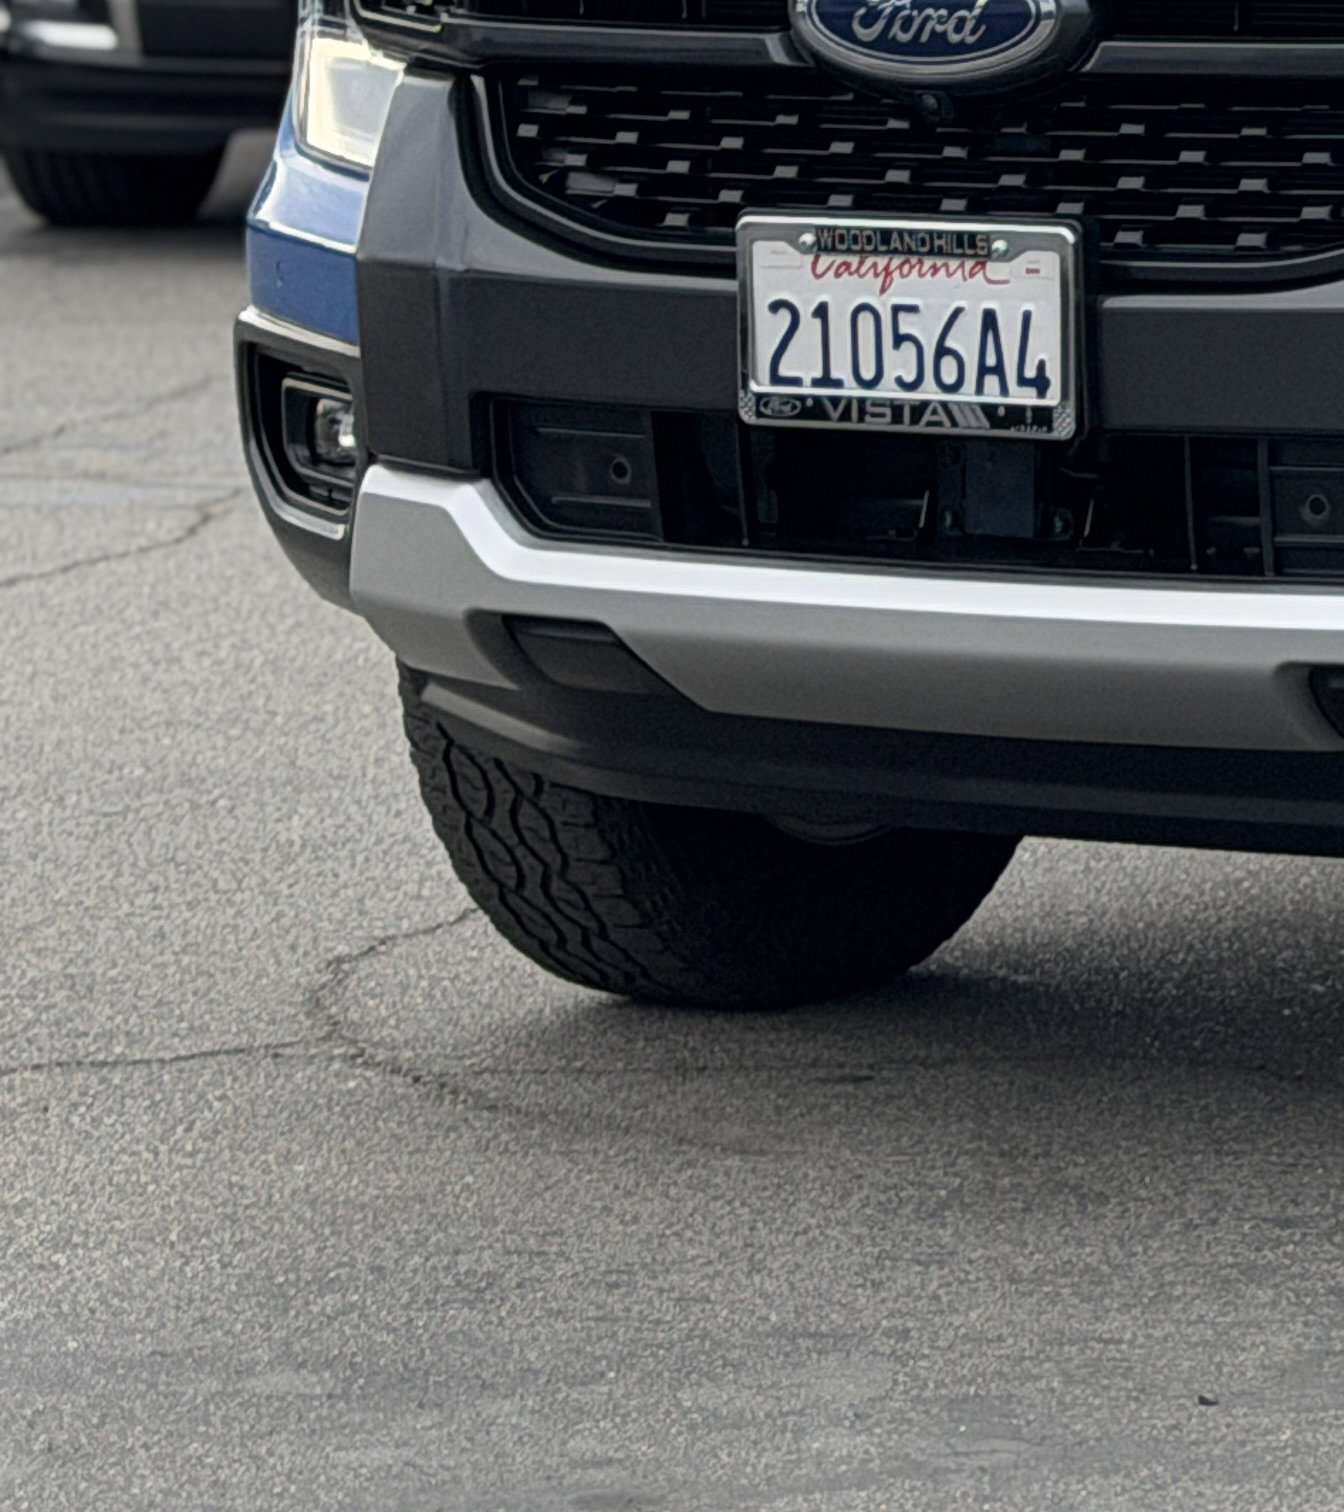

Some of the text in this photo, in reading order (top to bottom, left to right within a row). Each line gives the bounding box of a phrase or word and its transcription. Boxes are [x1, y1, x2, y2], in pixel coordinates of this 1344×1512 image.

[816, 228, 989, 256] WOODLAND HILLS
[810, 254, 1010, 297] California
[766, 297, 1052, 399] 21056A4
[821, 398, 953, 428] VISTA
